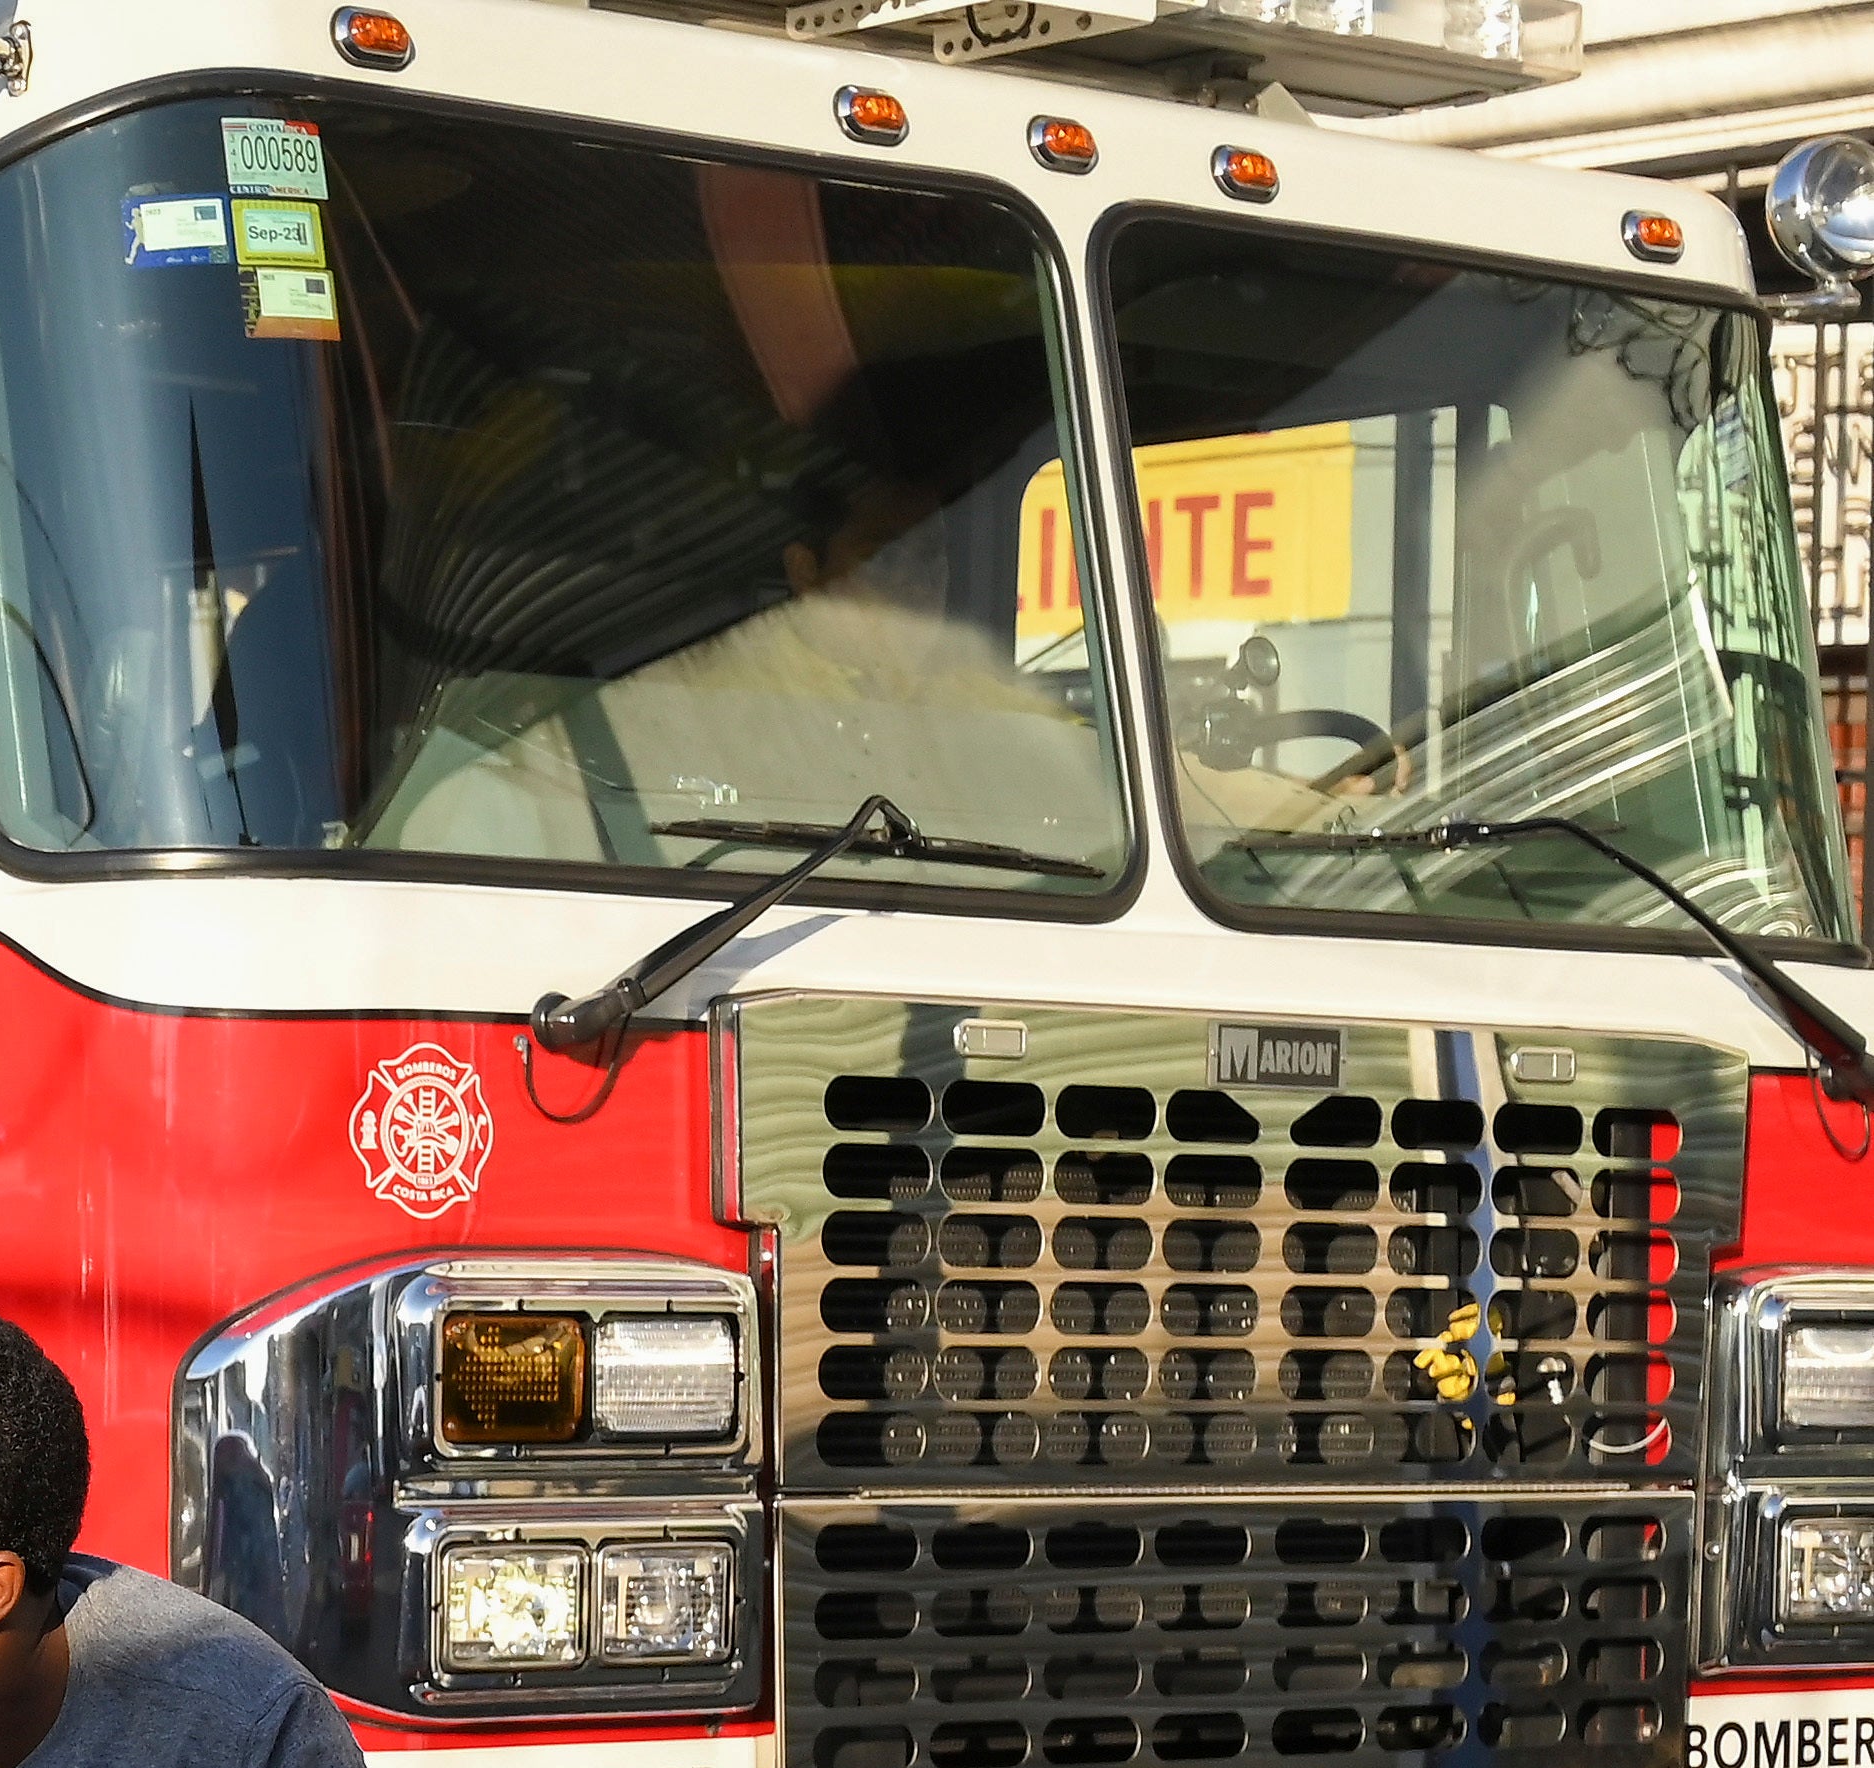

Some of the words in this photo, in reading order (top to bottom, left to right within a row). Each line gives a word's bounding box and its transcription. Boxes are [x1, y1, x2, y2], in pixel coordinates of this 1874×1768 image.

[248, 124, 282, 133] COSTA
[240, 135, 319, 174] 000589
[1220, 1027, 1333, 1081] MARION
[395, 1060, 458, 1081] BOMBEROS
